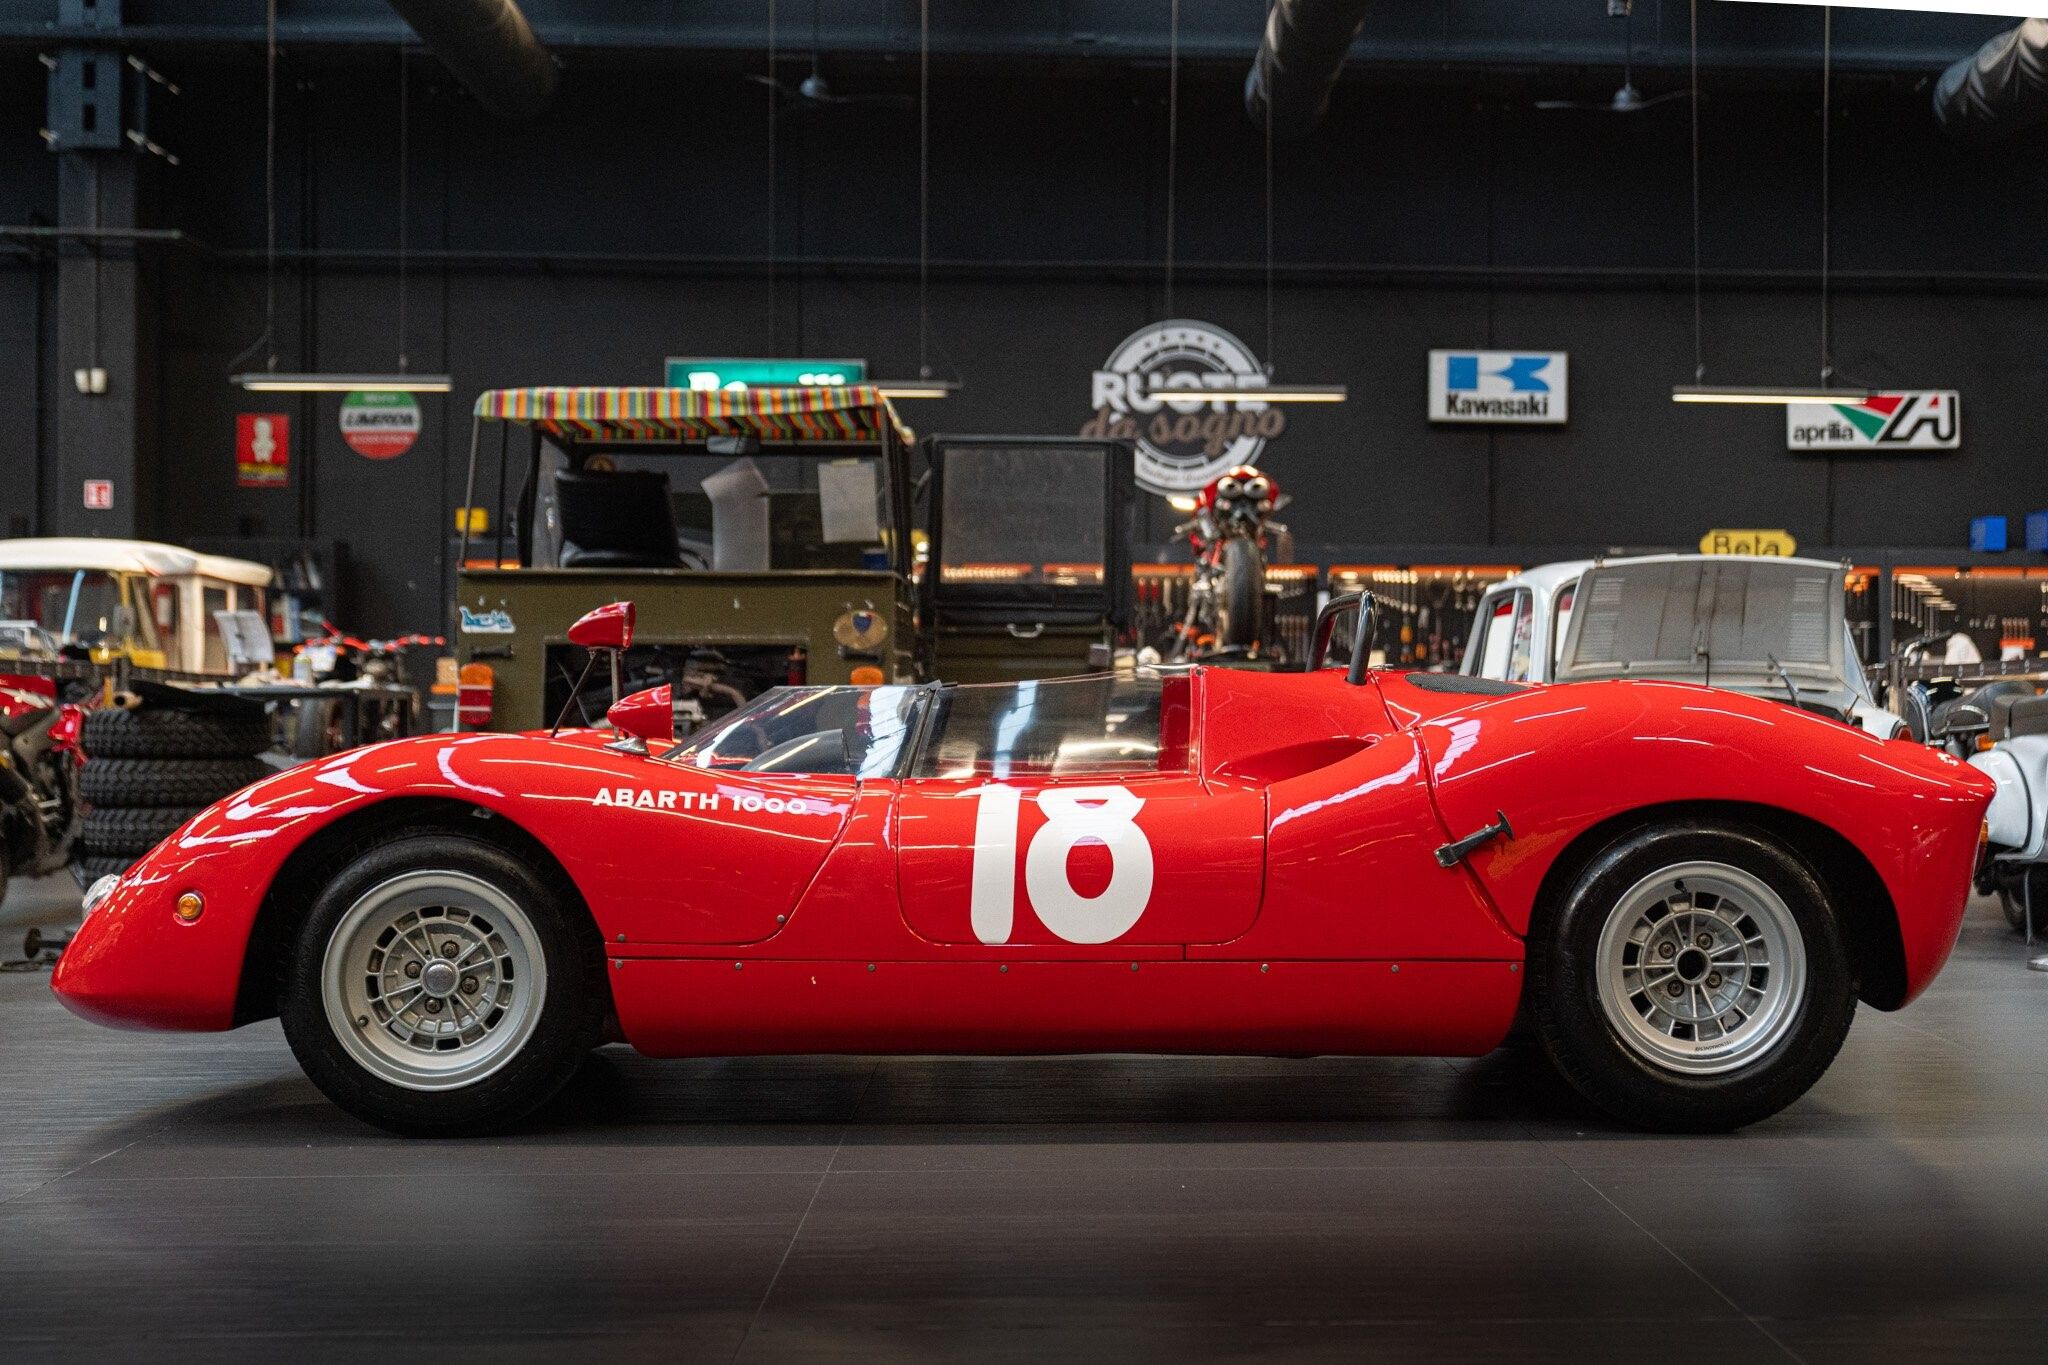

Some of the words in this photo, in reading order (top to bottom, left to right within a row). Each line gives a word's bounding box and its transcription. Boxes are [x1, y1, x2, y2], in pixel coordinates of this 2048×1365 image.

[1446, 393, 1549, 416] Kawasaki
[1149, 408, 1286, 456] sogno
[1792, 421, 1854, 445] aprilia
[592, 787, 720, 811] ABARTH
[732, 794, 807, 815] 1000
[967, 783, 1154, 944] 18
